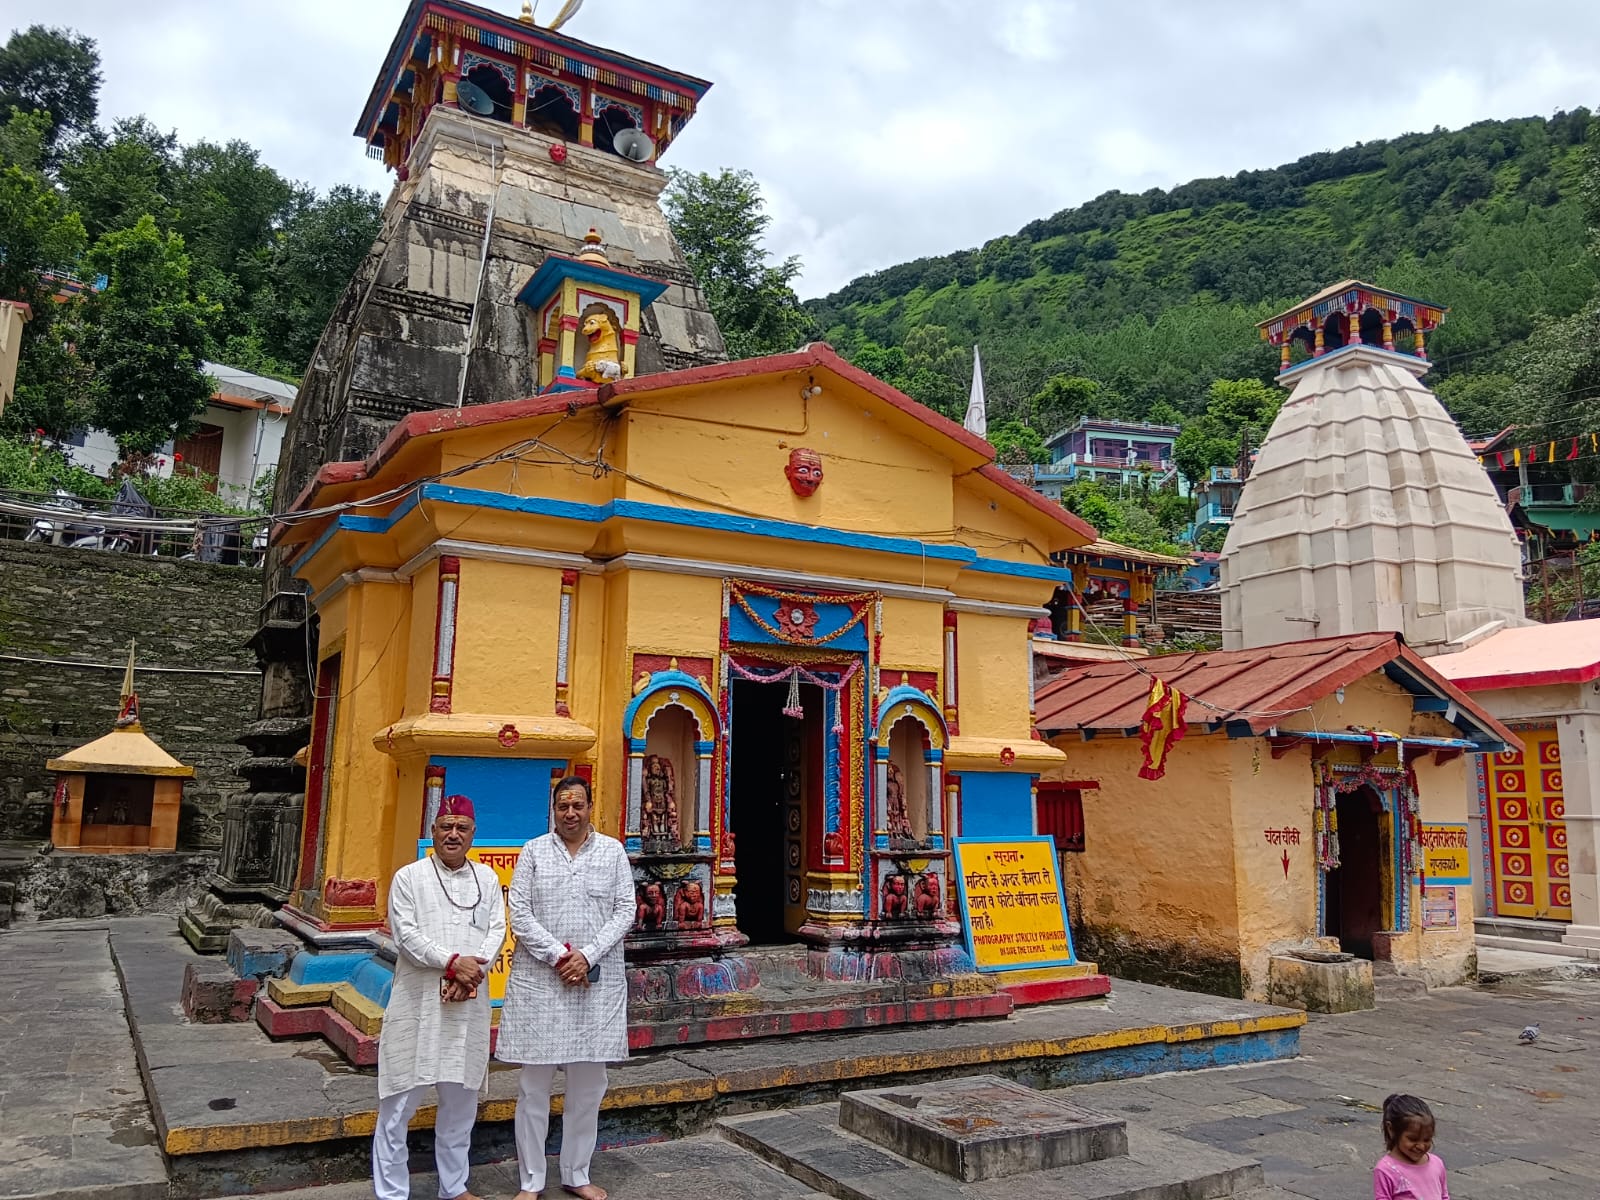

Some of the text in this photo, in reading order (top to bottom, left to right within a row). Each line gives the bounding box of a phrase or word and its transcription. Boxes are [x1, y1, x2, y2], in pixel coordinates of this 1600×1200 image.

[993, 850, 1019, 867] सूचना
[965, 871, 990, 890] मन्दिर
[990, 871, 999, 888] के
[1000, 873, 1021, 888] अन्दर
[1042, 867, 1051, 885] ले
[968, 896, 987, 910] जाना
[988, 895, 995, 909] व
[970, 916, 984, 930] मना
[973, 934, 1014, 946] PHOTOGRAPHY
[1015, 932, 1038, 943] STRICTLY
[1026, 944, 1046, 954] TEMPLE
